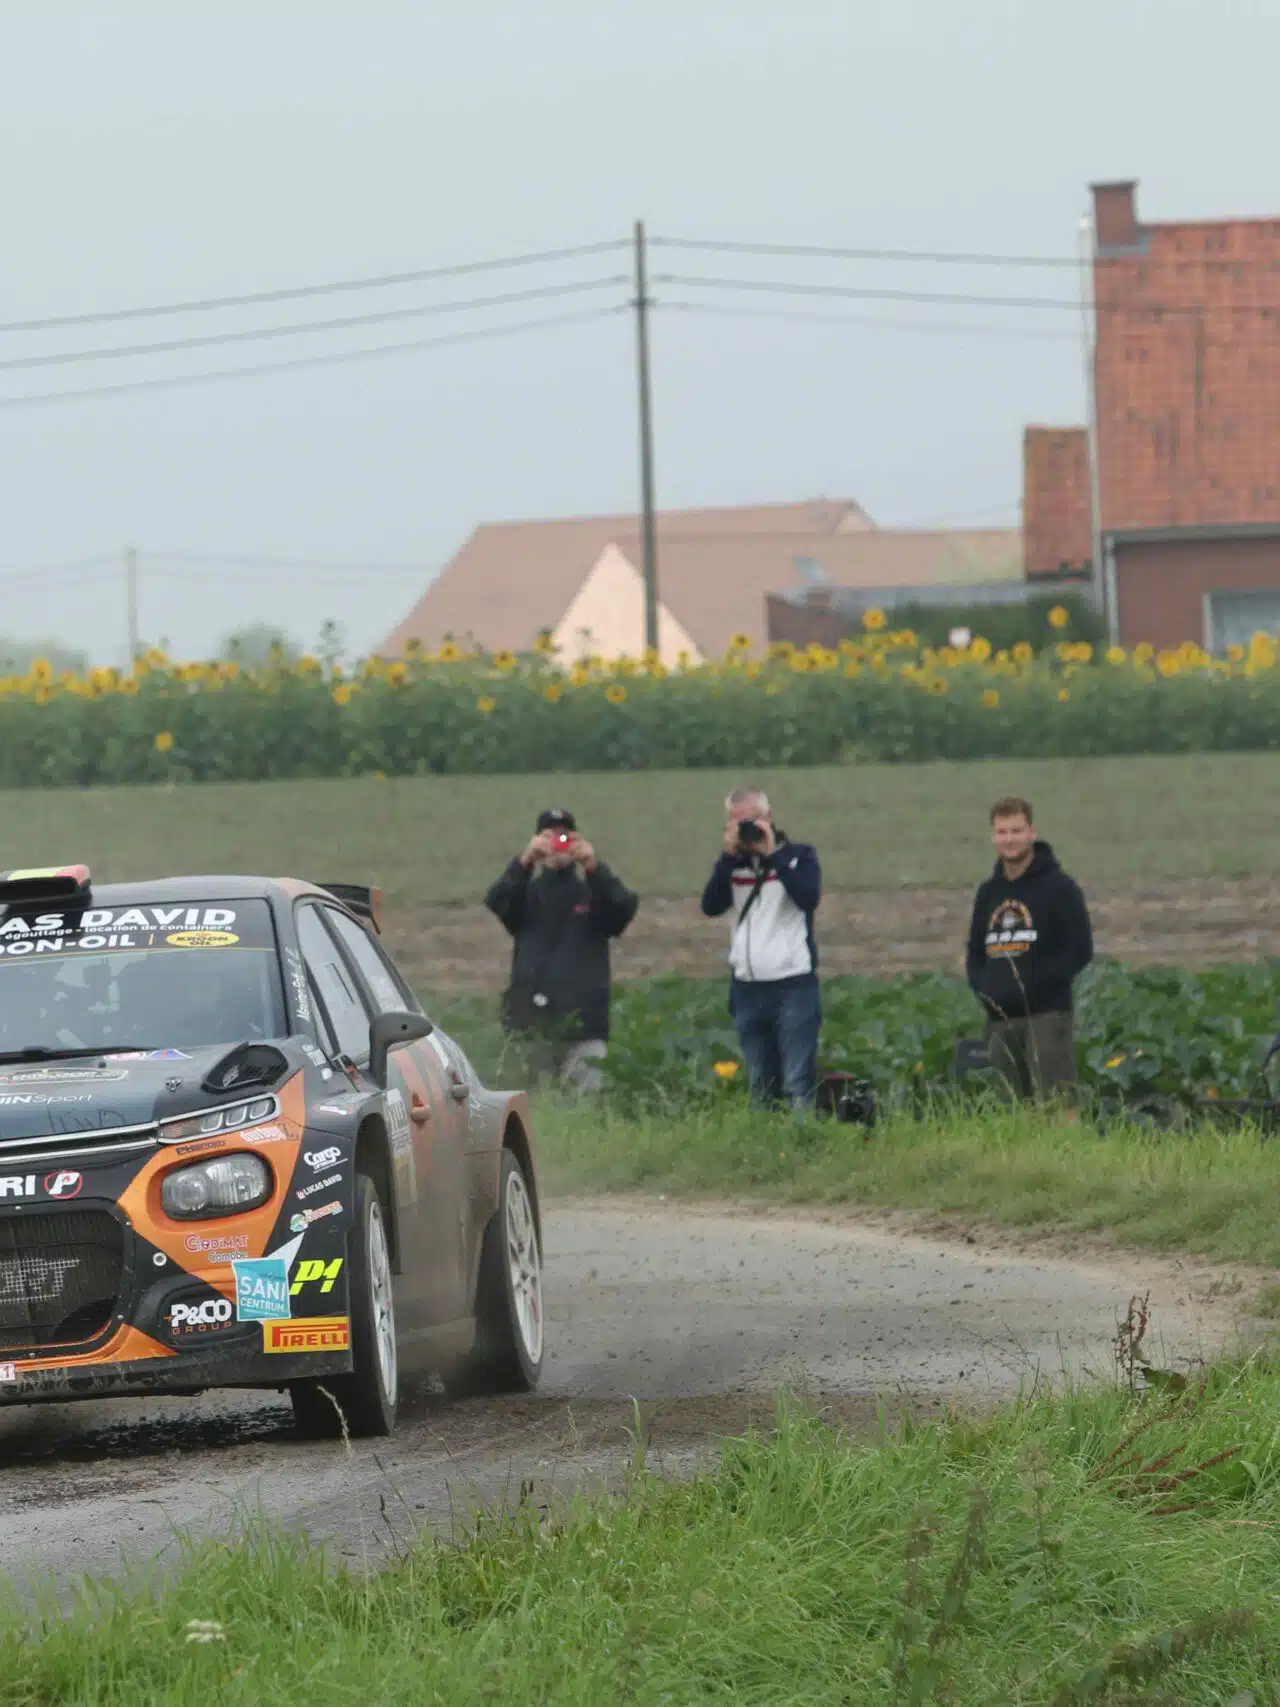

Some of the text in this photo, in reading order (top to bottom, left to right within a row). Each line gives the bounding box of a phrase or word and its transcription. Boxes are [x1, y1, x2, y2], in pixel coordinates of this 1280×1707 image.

[80, 908, 237, 928] DAVID
[4, 928, 73, 941] égouttage
[85, 924, 138, 932] location
[141, 924, 158, 932] de
[160, 923, 232, 932] containers
[303, 1146, 342, 1167] Cargo
[303, 1181, 325, 1195] LUCAS
[322, 1173, 343, 1188] DAVID
[288, 1258, 345, 1296] P1
[239, 1276, 287, 1300] SANI
[170, 1298, 233, 1328] P&CO
[239, 1296, 285, 1313] CENTRUM
[172, 1321, 233, 1336] GROUP
